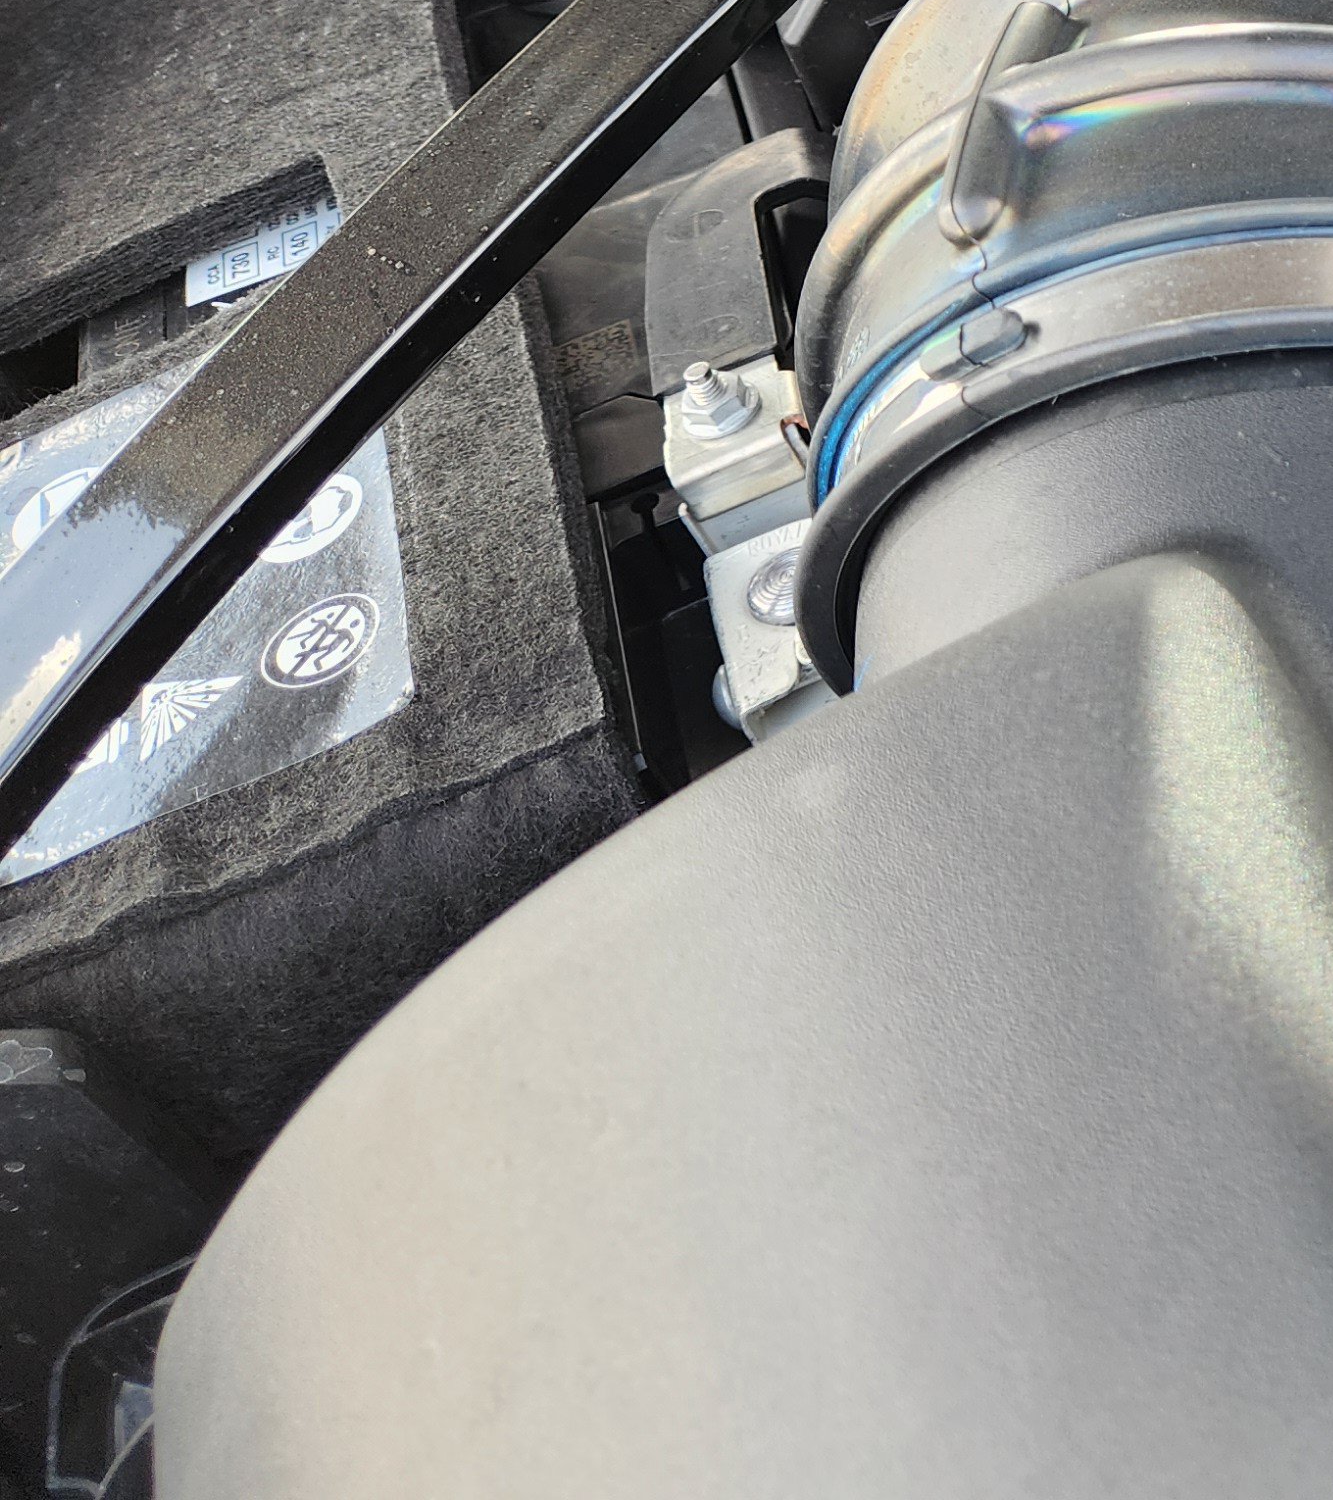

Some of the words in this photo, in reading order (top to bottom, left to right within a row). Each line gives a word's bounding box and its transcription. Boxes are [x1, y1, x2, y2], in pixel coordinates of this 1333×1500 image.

[267, 245, 281, 261] RC
[291, 231, 310, 257] 140
[207, 263, 221, 285] CCA
[231, 252, 251, 279] 730
